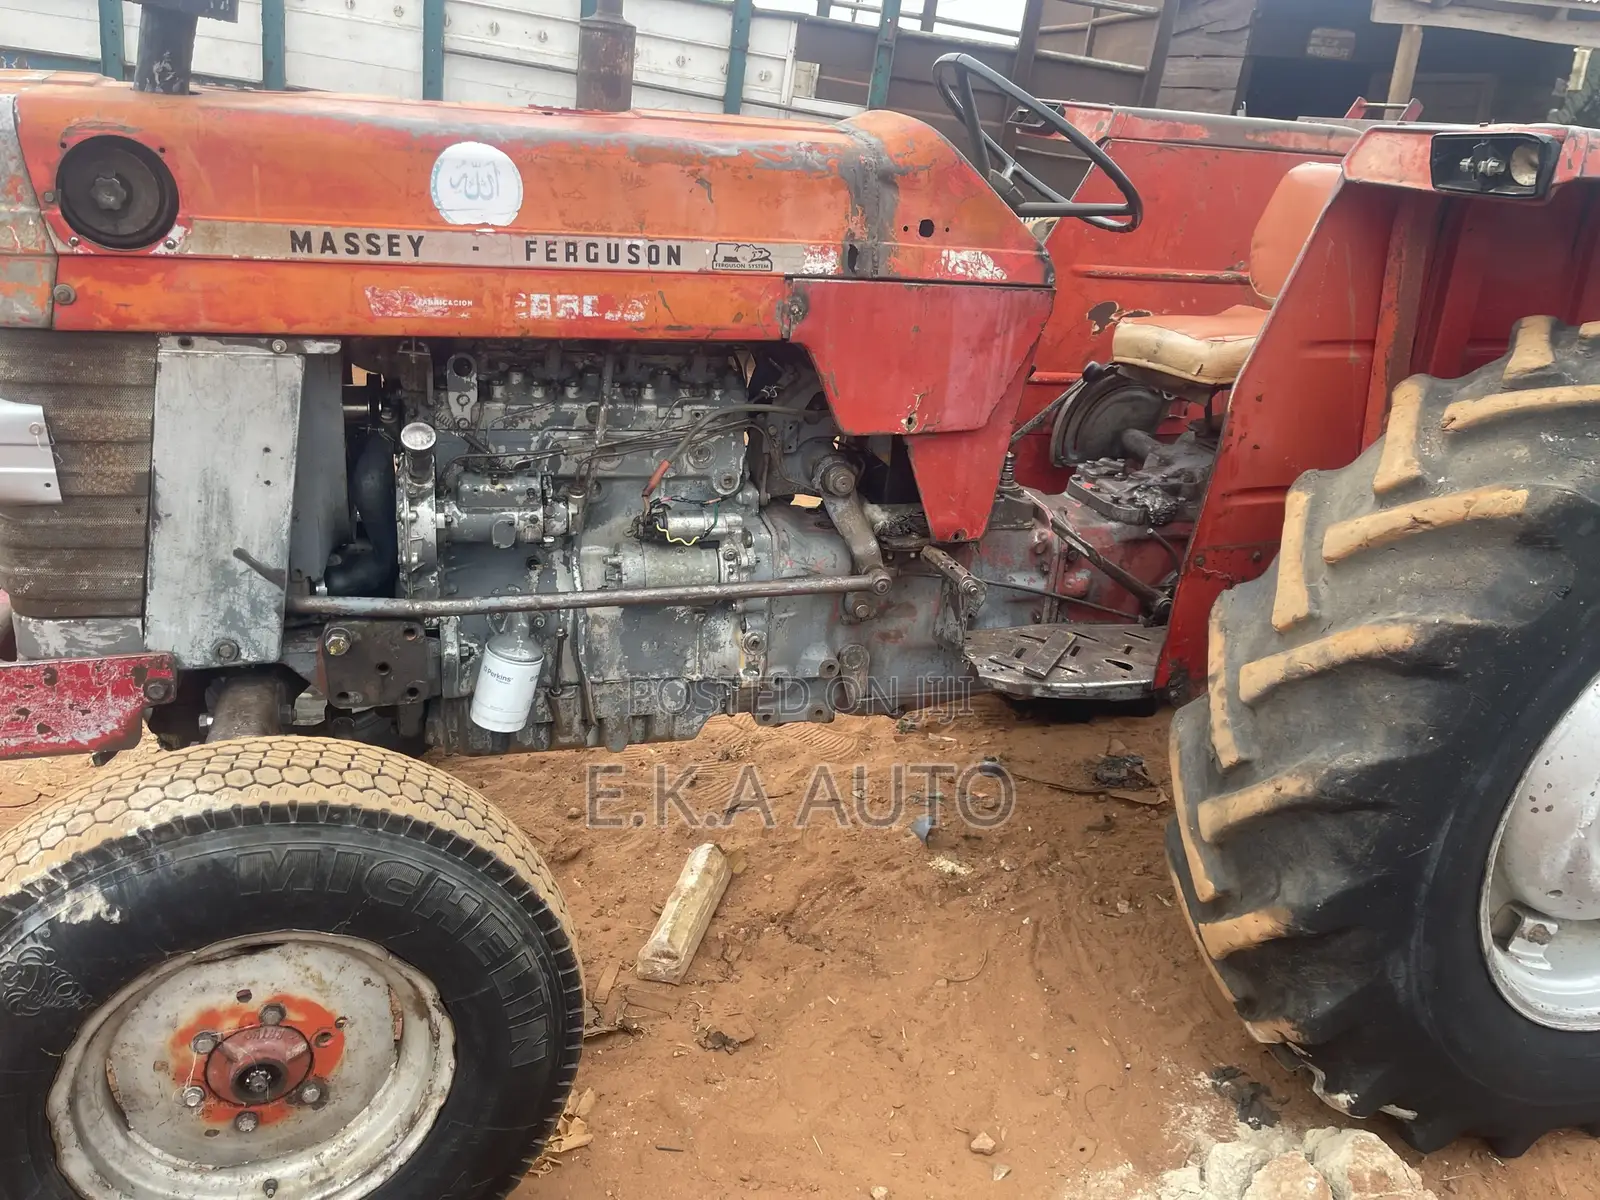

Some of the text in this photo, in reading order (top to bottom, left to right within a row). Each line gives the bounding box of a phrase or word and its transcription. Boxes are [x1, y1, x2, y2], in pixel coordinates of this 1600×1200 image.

[290, 230, 424, 257] MASSEY
[525, 240, 681, 266] FERGUSON
[487, 668, 513, 682] Perkins
[236, 847, 549, 1068] MICHELIN
